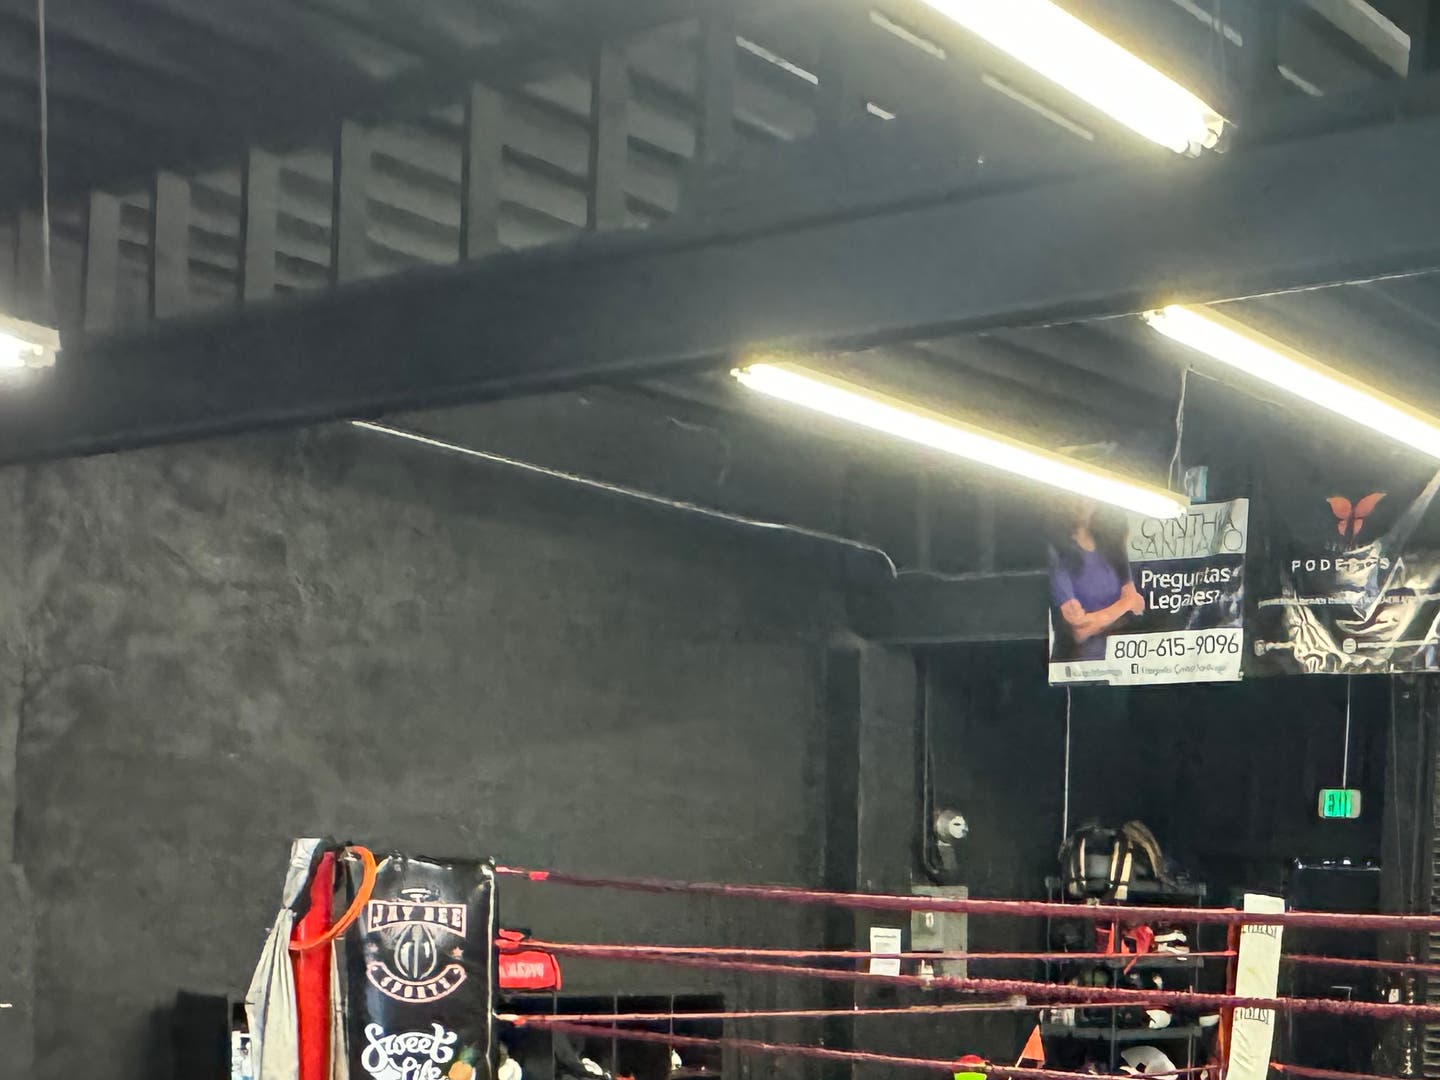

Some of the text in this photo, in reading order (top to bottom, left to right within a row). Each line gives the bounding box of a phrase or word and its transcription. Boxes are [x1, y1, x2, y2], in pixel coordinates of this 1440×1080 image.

[1141, 567, 1231, 593] Preguntas
[1149, 590, 1220, 614] Legales?
[1114, 634, 1239, 659] 800-615-9096
[361, 1022, 457, 1074] Sweet
